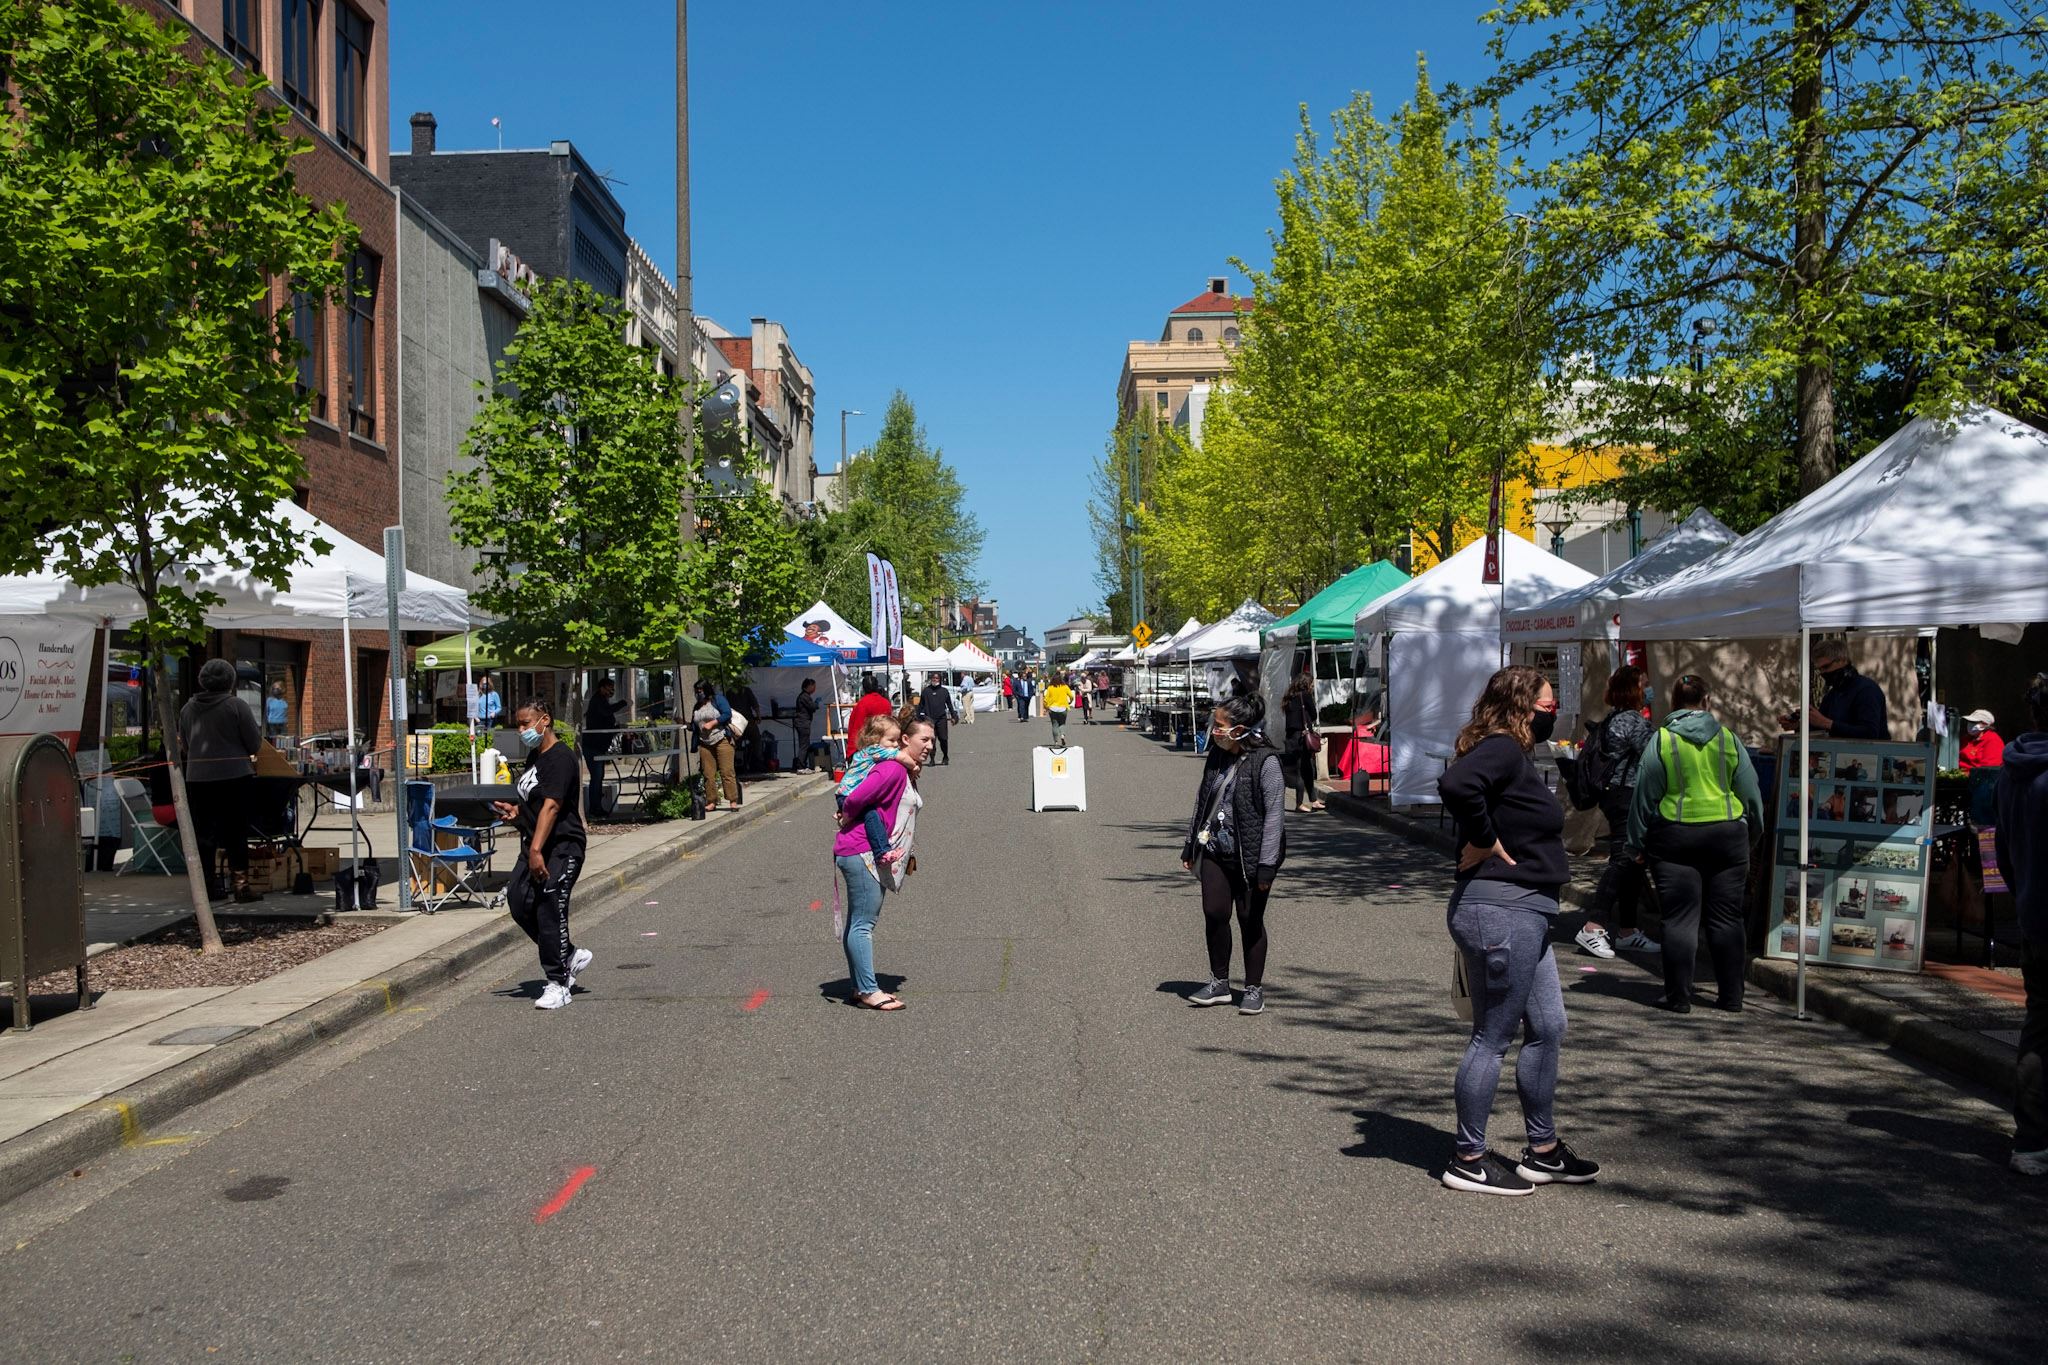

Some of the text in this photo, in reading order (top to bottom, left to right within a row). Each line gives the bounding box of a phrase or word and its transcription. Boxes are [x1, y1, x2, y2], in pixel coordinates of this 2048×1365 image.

[1505, 619, 1531, 632] CHOCOLATE
[1534, 617, 1556, 631] CARAMEL
[1556, 615, 1575, 629] APPLES
[38, 642, 75, 654] Handcrafted
[24, 689, 77, 700] Home Care Products
[38, 703, 44, 713] &
